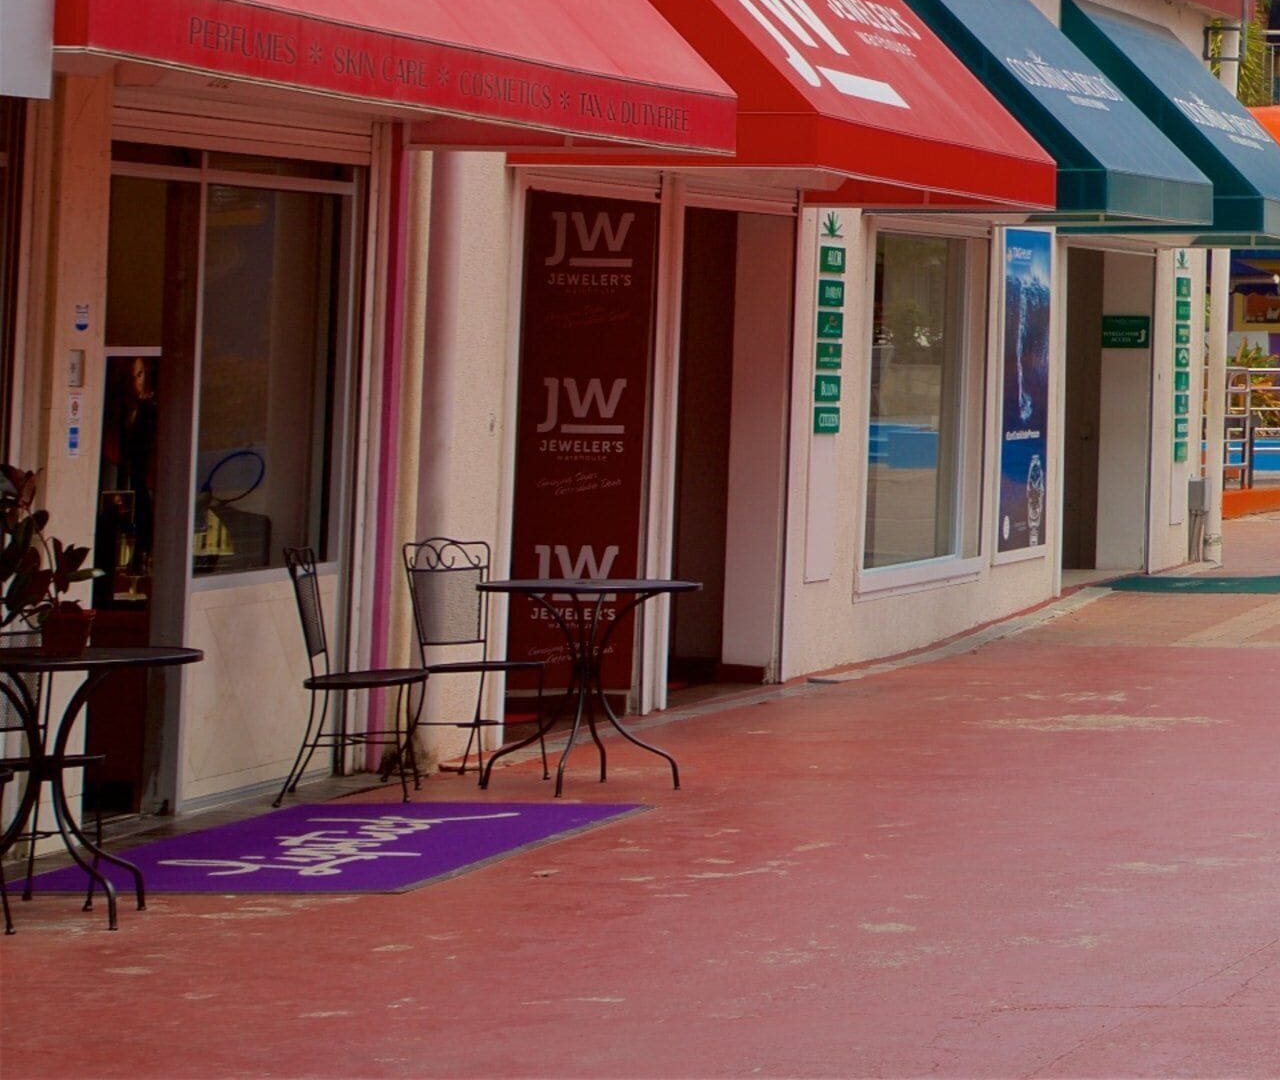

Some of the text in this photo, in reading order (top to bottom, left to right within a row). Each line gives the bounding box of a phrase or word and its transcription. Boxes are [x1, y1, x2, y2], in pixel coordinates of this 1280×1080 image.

[188, 16, 297, 65] PERFUMES
[332, 45, 377, 79] SKIN
[381, 55, 428, 88] CARE
[458, 70, 552, 110] COSMETICS
[579, 92, 603, 119] TAX
[606, 98, 617, 121] &
[545, 211, 635, 266] JW
[546, 272, 633, 287] JEWELER'S
[537, 376, 628, 433] JW
[539, 438, 625, 453] JEWELER'S
